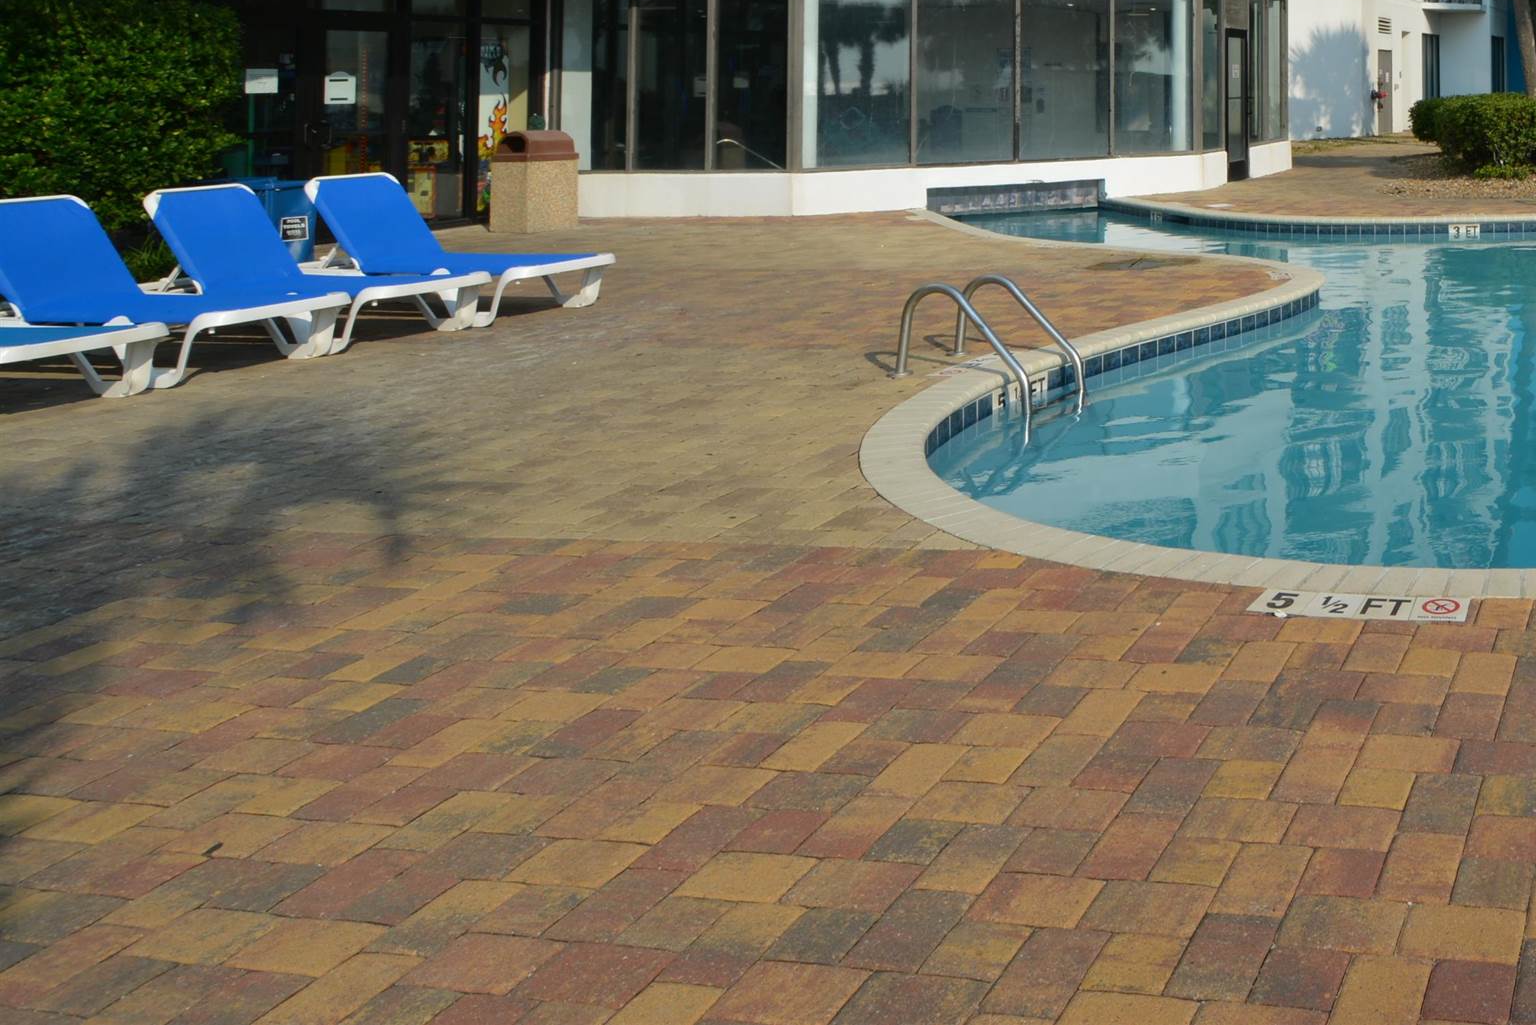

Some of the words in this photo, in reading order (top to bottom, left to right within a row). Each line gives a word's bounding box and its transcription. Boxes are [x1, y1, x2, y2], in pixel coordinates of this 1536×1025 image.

[1453, 226, 1460, 239] 3
[1266, 592, 1299, 609] 5
[1360, 598, 1412, 616] FT
